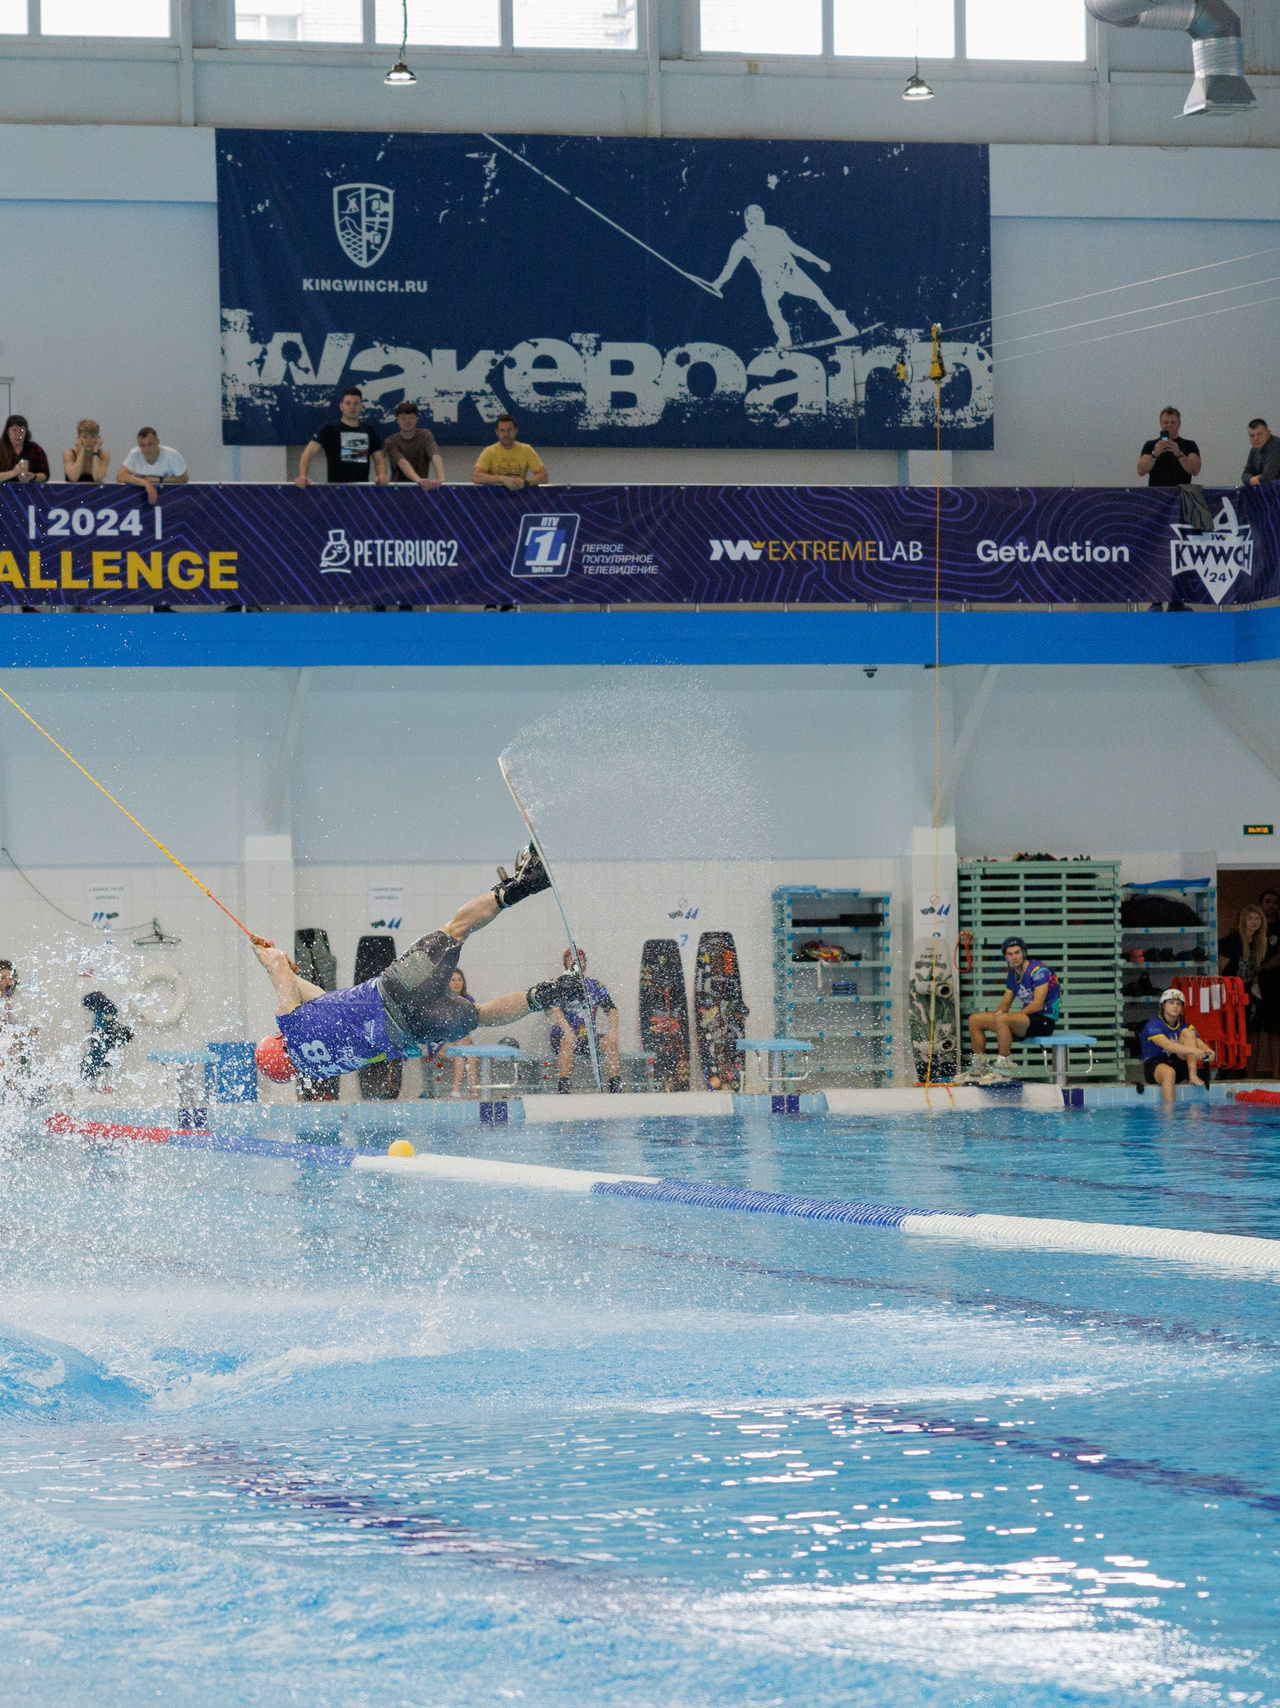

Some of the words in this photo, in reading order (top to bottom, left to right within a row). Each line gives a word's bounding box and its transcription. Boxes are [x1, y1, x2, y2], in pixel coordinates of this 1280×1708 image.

[302, 278, 428, 293] KINGWINCH.RU
[353, 539, 459, 567] PETERBURG2
[581, 544, 625, 553] ПЕРВОЕ
[768, 540, 923, 562] EXTREMELAB
[976, 539, 1130, 563] GetAction
[581, 554, 654, 564] ПОПУЛЯРНОЕ
[583, 565, 659, 575] ТЕЛЕВИДЕНИЕ
[680, 934, 689, 947] 7
